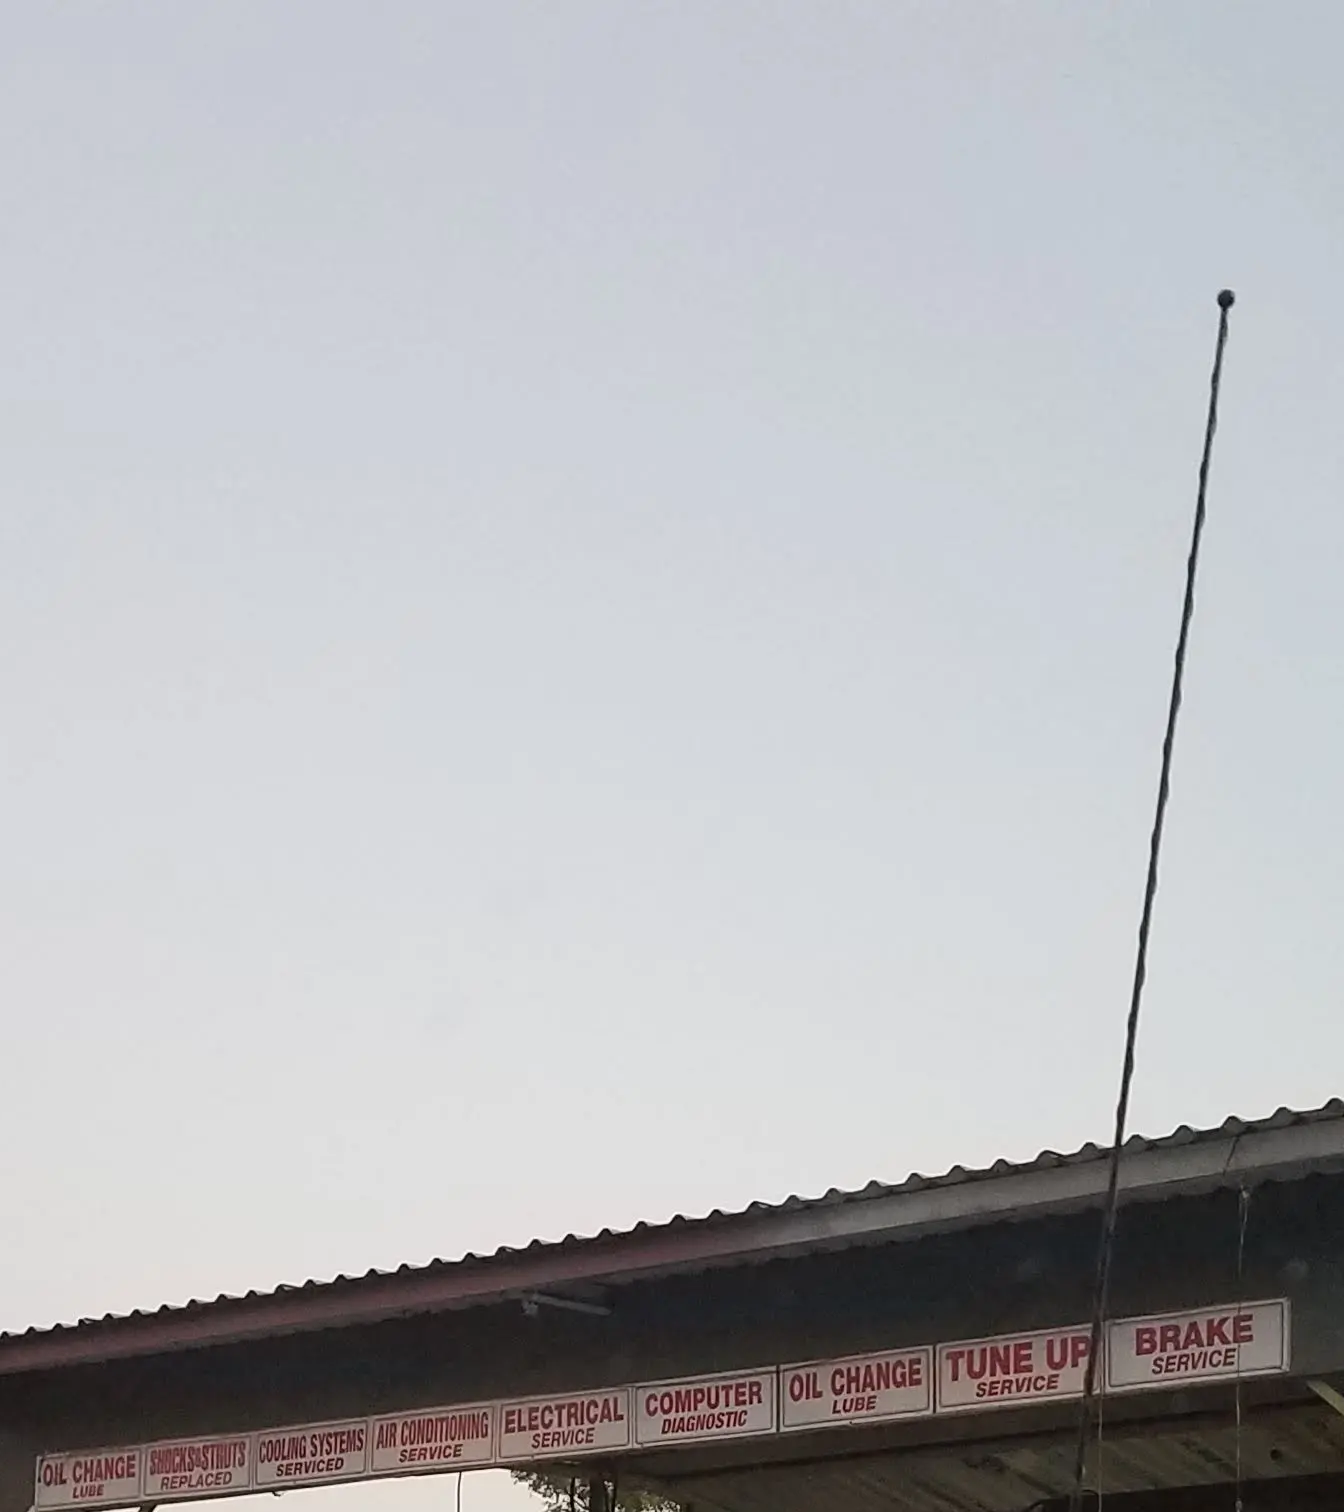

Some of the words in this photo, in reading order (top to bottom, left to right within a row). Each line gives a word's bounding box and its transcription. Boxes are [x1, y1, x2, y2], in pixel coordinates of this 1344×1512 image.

[1135, 1313, 1254, 1357] BRAKE
[946, 1342, 1035, 1382] TUNE
[1045, 1335, 1093, 1370] UP
[1151, 1347, 1237, 1376] SERVICE
[789, 1371, 823, 1402] OIL
[831, 1357, 923, 1397] CHANGE
[975, 1373, 1060, 1399] SERVICE
[645, 1381, 763, 1418] COMPUTER
[832, 1394, 877, 1414] LUBE
[504, 1396, 625, 1435] ELECTRICAL
[660, 1409, 748, 1435] DIAGNOSTIC
[376, 1426, 398, 1450] AIR
[401, 1412, 489, 1446] CONDITIONING
[531, 1428, 595, 1449] SERVICE
[259, 1438, 308, 1464] COOLING
[310, 1428, 365, 1458] SYSTEMS
[399, 1444, 463, 1464] SERVICE
[42, 1465, 67, 1486] OIL
[72, 1454, 136, 1483] CHANGE
[160, 1471, 233, 1491] REPLACED
[275, 1458, 345, 1477] SERVICED
[72, 1484, 105, 1499] LUBE
